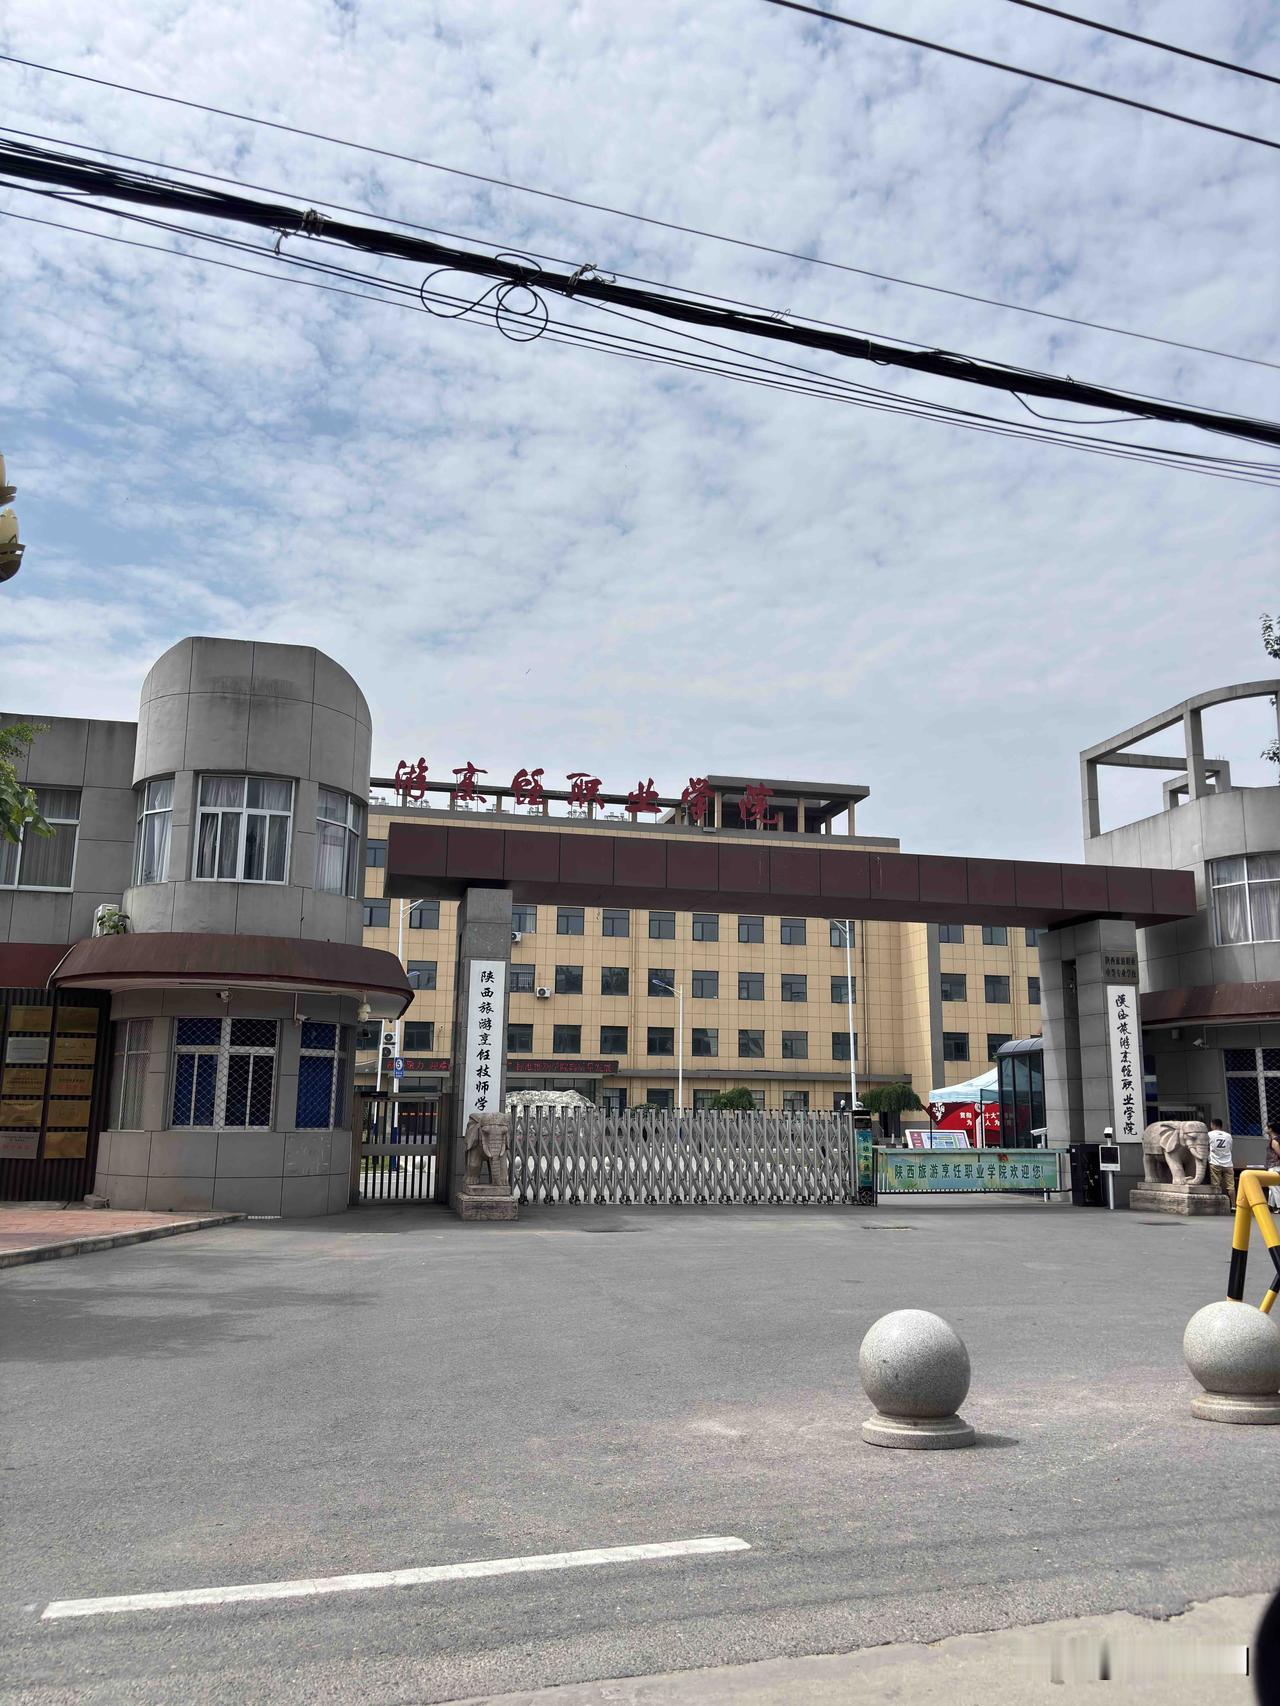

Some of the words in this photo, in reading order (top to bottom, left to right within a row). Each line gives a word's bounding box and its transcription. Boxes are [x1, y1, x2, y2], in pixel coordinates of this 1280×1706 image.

[1115, 994, 1138, 1136] 陕西旅游烹饪职业学院
[894, 1164, 1044, 1180] 陕西旅游烹饪职业学院欢迎您!
